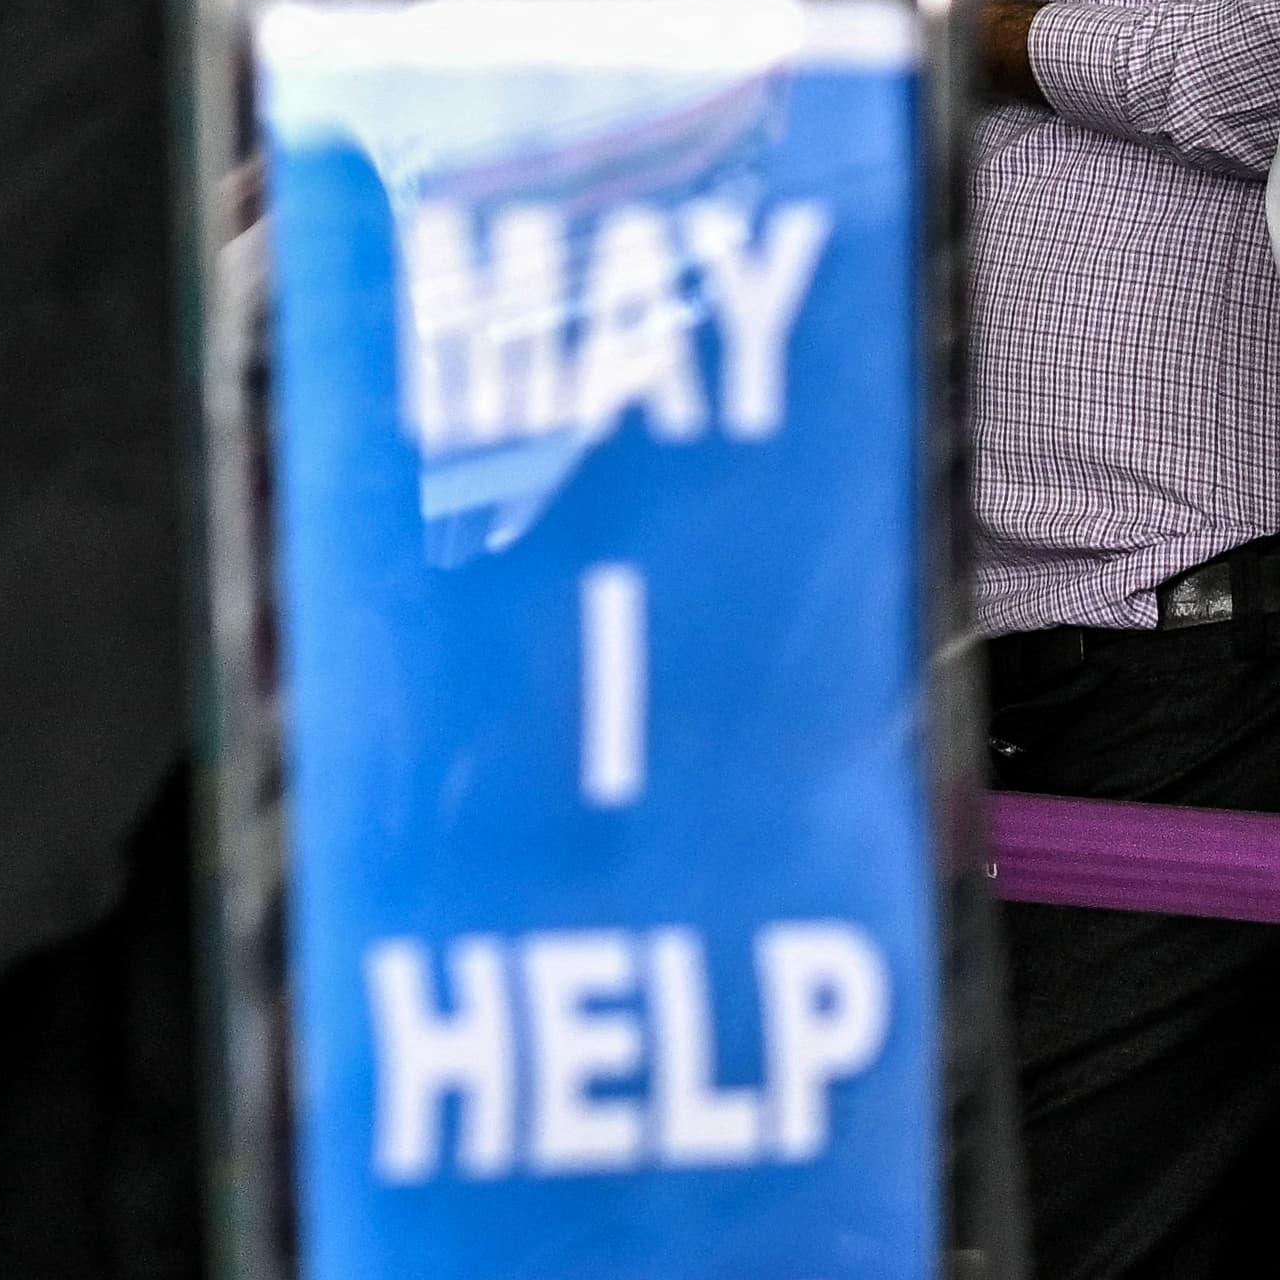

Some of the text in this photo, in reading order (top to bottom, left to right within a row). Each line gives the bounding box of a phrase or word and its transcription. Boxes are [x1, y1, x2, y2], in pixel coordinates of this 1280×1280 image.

[402, 198, 832, 442] MAY
[578, 562, 646, 810] I
[366, 922, 891, 1183] HELP
